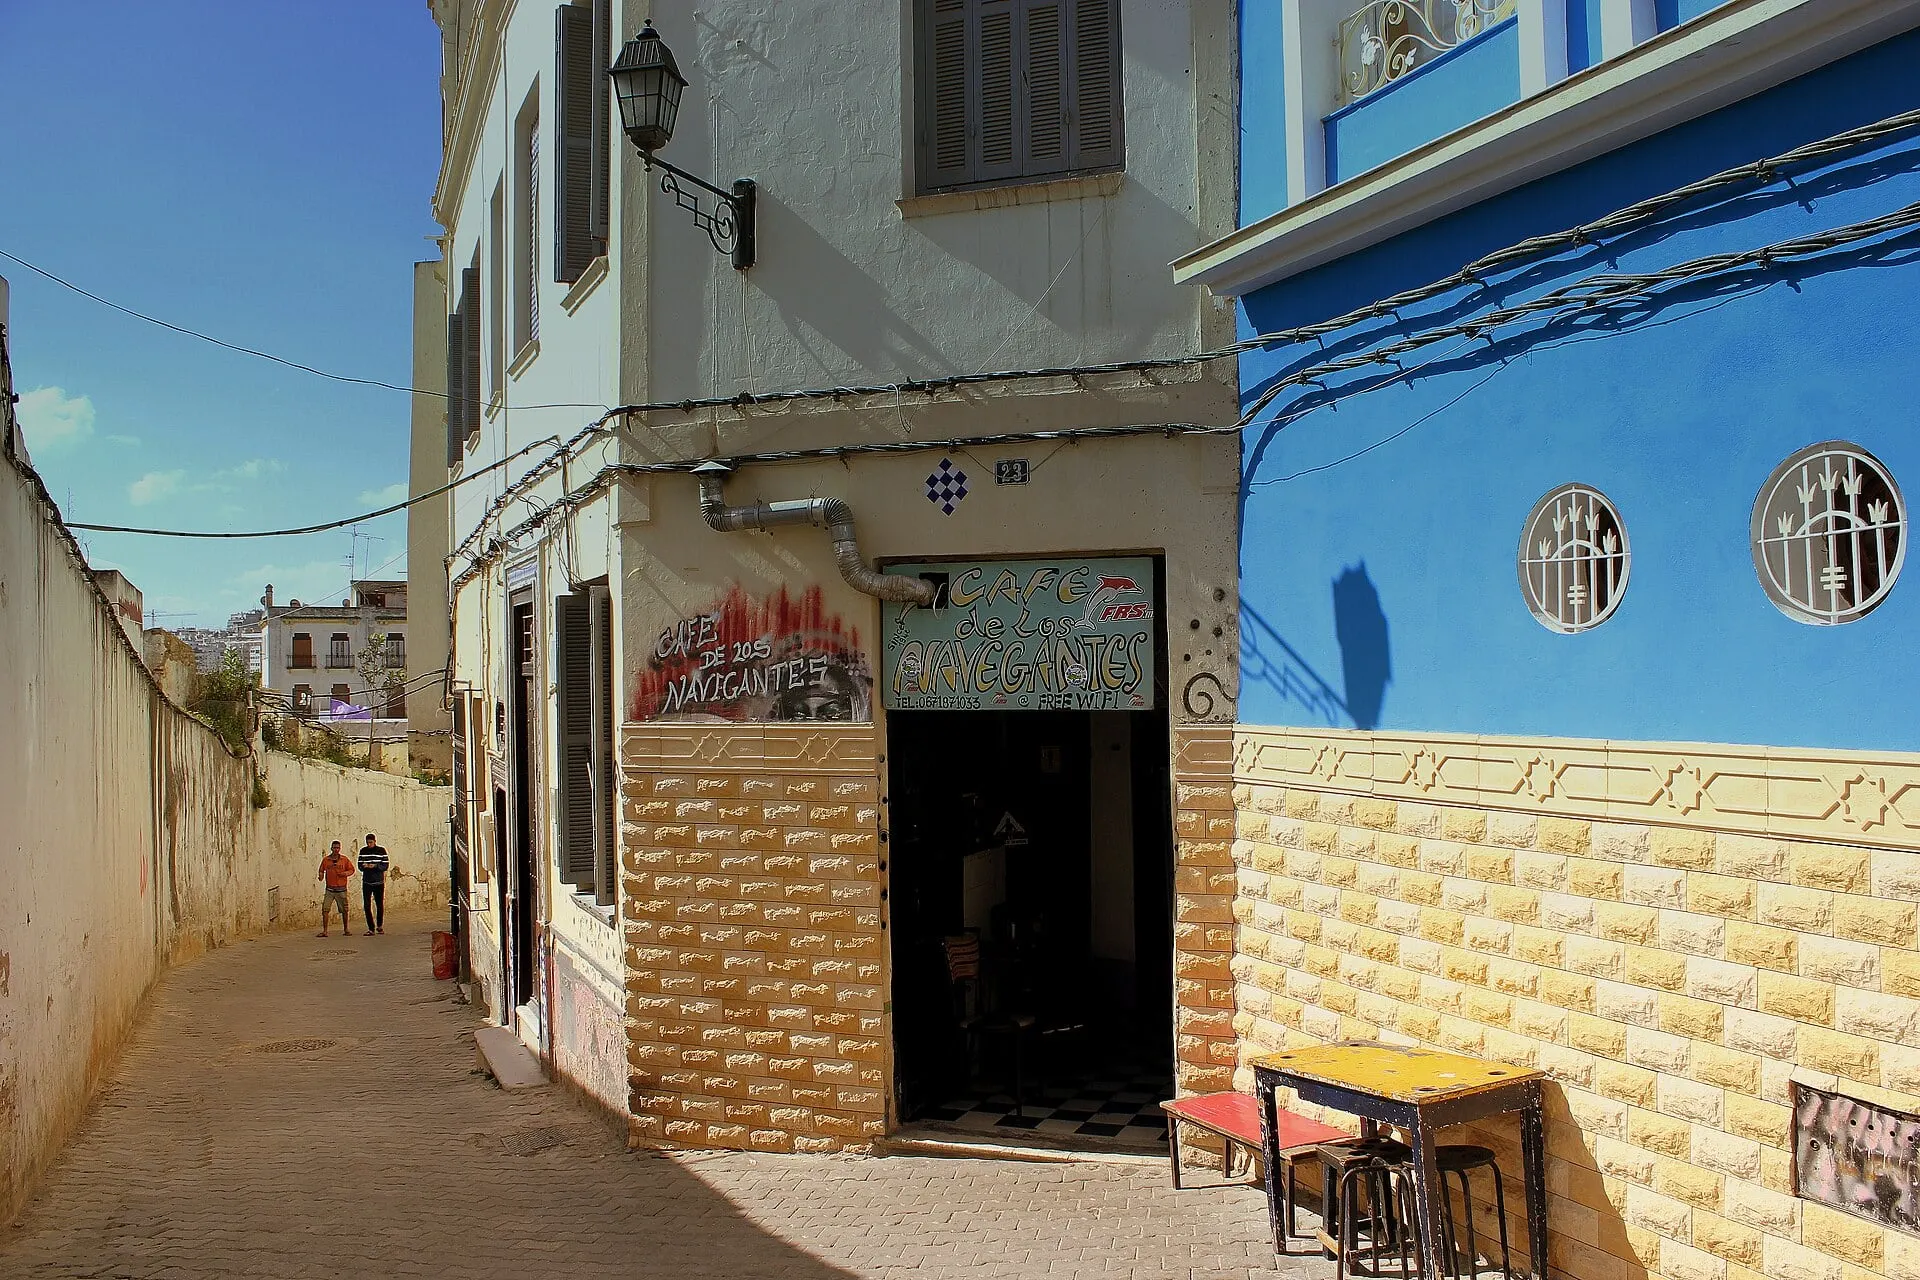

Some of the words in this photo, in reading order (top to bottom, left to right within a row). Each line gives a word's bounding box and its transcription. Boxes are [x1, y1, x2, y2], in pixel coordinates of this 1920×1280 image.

[1001, 462, 1022, 482] 23
[950, 566, 1090, 608] CAFE
[657, 616, 718, 658] CAFE
[955, 606, 1006, 640] de
[1011, 606, 1075, 639] Los
[699, 644, 726, 670] DE
[892, 632, 1148, 695] NAVEGANTES
[661, 655, 828, 714] NAVEGANTES
[1038, 692, 1073, 710] FREE
[1076, 690, 1120, 709] WIFI
